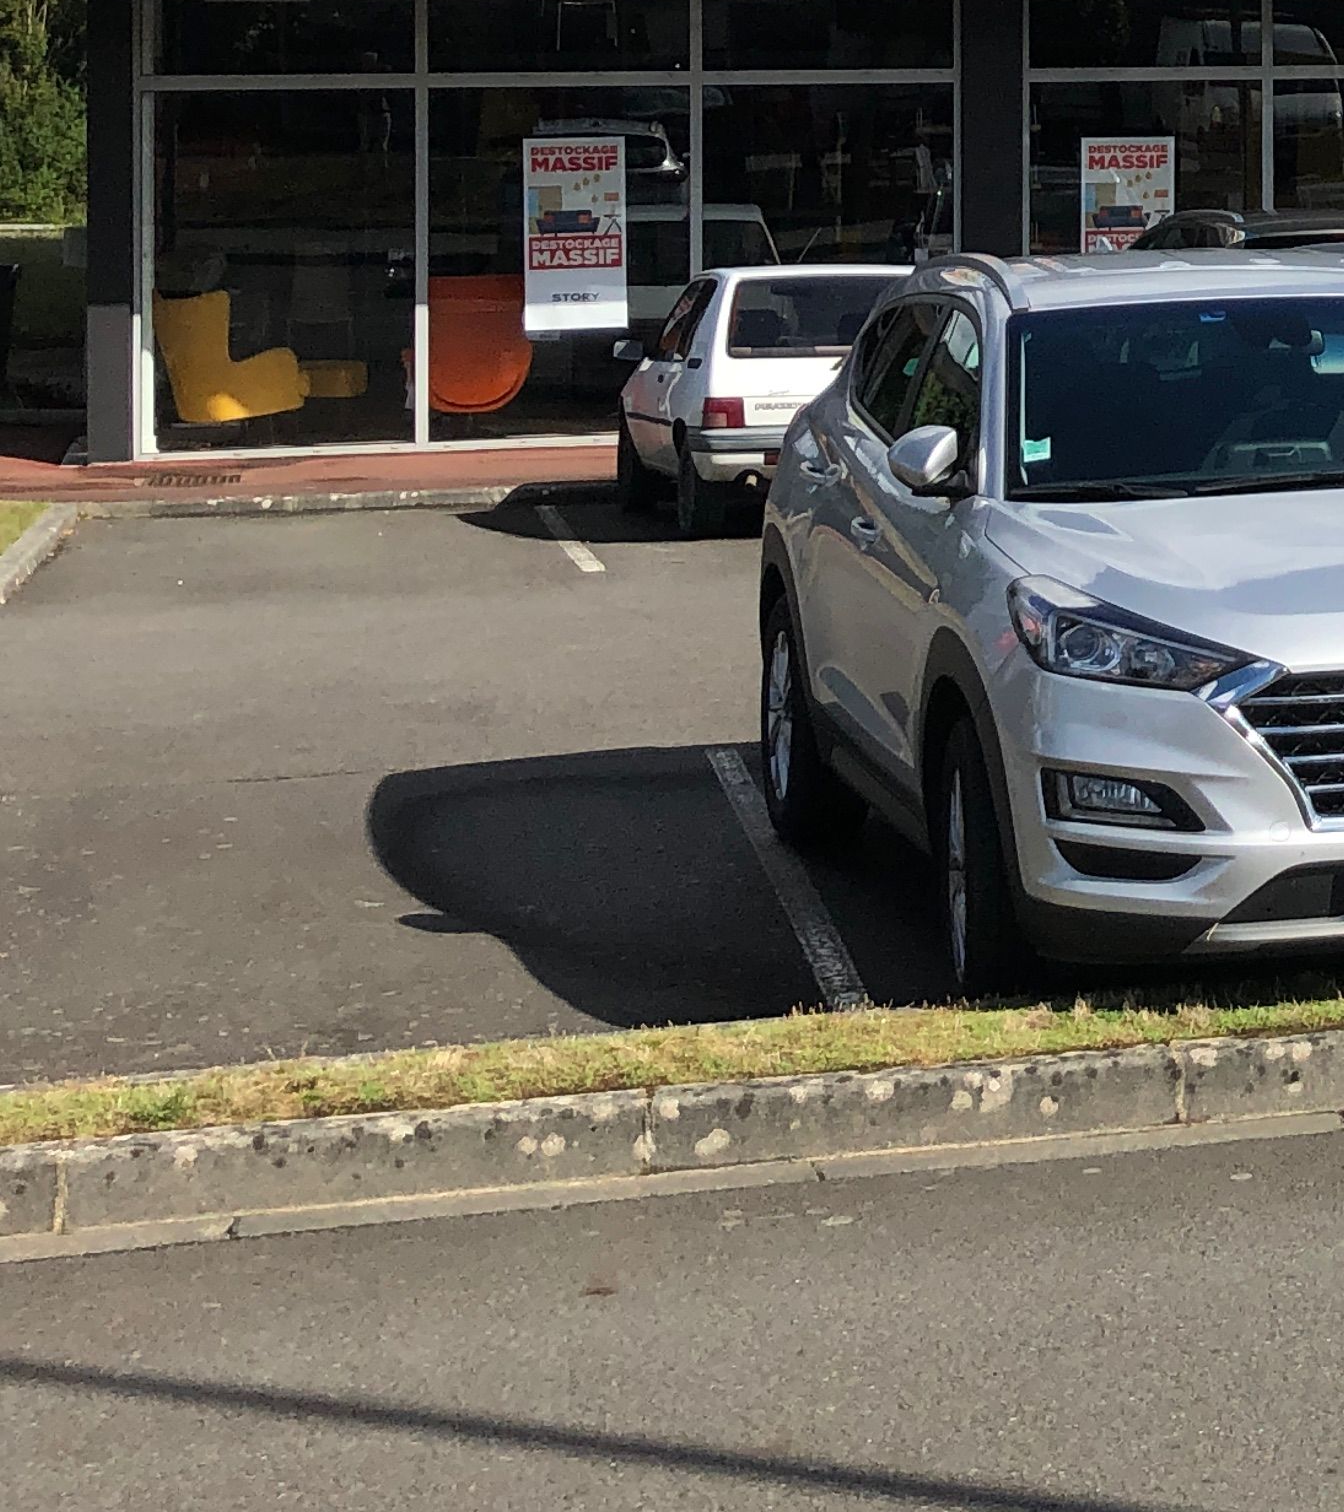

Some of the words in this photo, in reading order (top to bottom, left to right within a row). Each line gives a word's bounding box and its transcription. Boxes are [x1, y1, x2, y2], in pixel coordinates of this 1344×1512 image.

[531, 145, 618, 156] DESTOCKAGE
[1088, 144, 1168, 154] DESTOCKAGE
[531, 156, 618, 172] MASSIF
[1088, 154, 1168, 169] MASSIF
[531, 238, 619, 250] DESTOCKAGE
[532, 249, 619, 267] MASSIF
[552, 292, 600, 302] STORY
